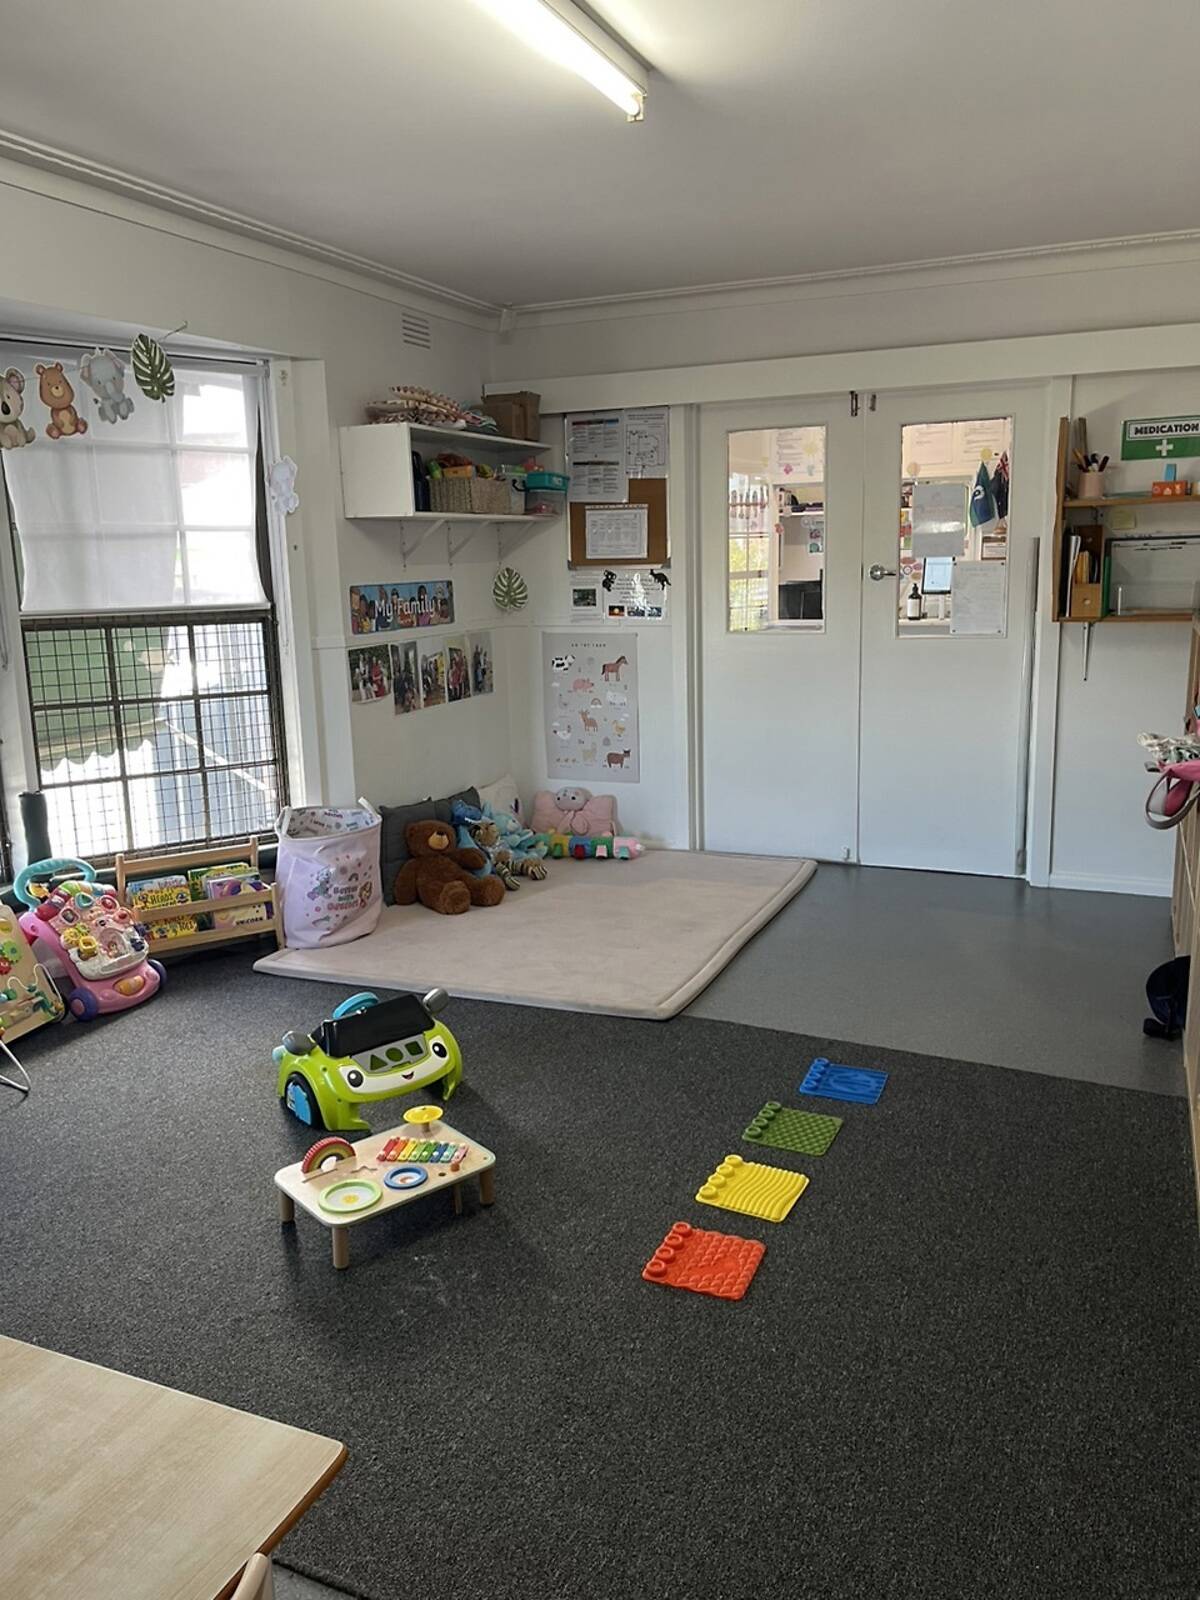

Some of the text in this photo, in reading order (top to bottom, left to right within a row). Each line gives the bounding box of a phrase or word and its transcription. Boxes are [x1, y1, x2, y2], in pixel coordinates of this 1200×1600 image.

[1134, 423, 1200, 435] MEDICATION
[374, 595, 435, 622] My Family
